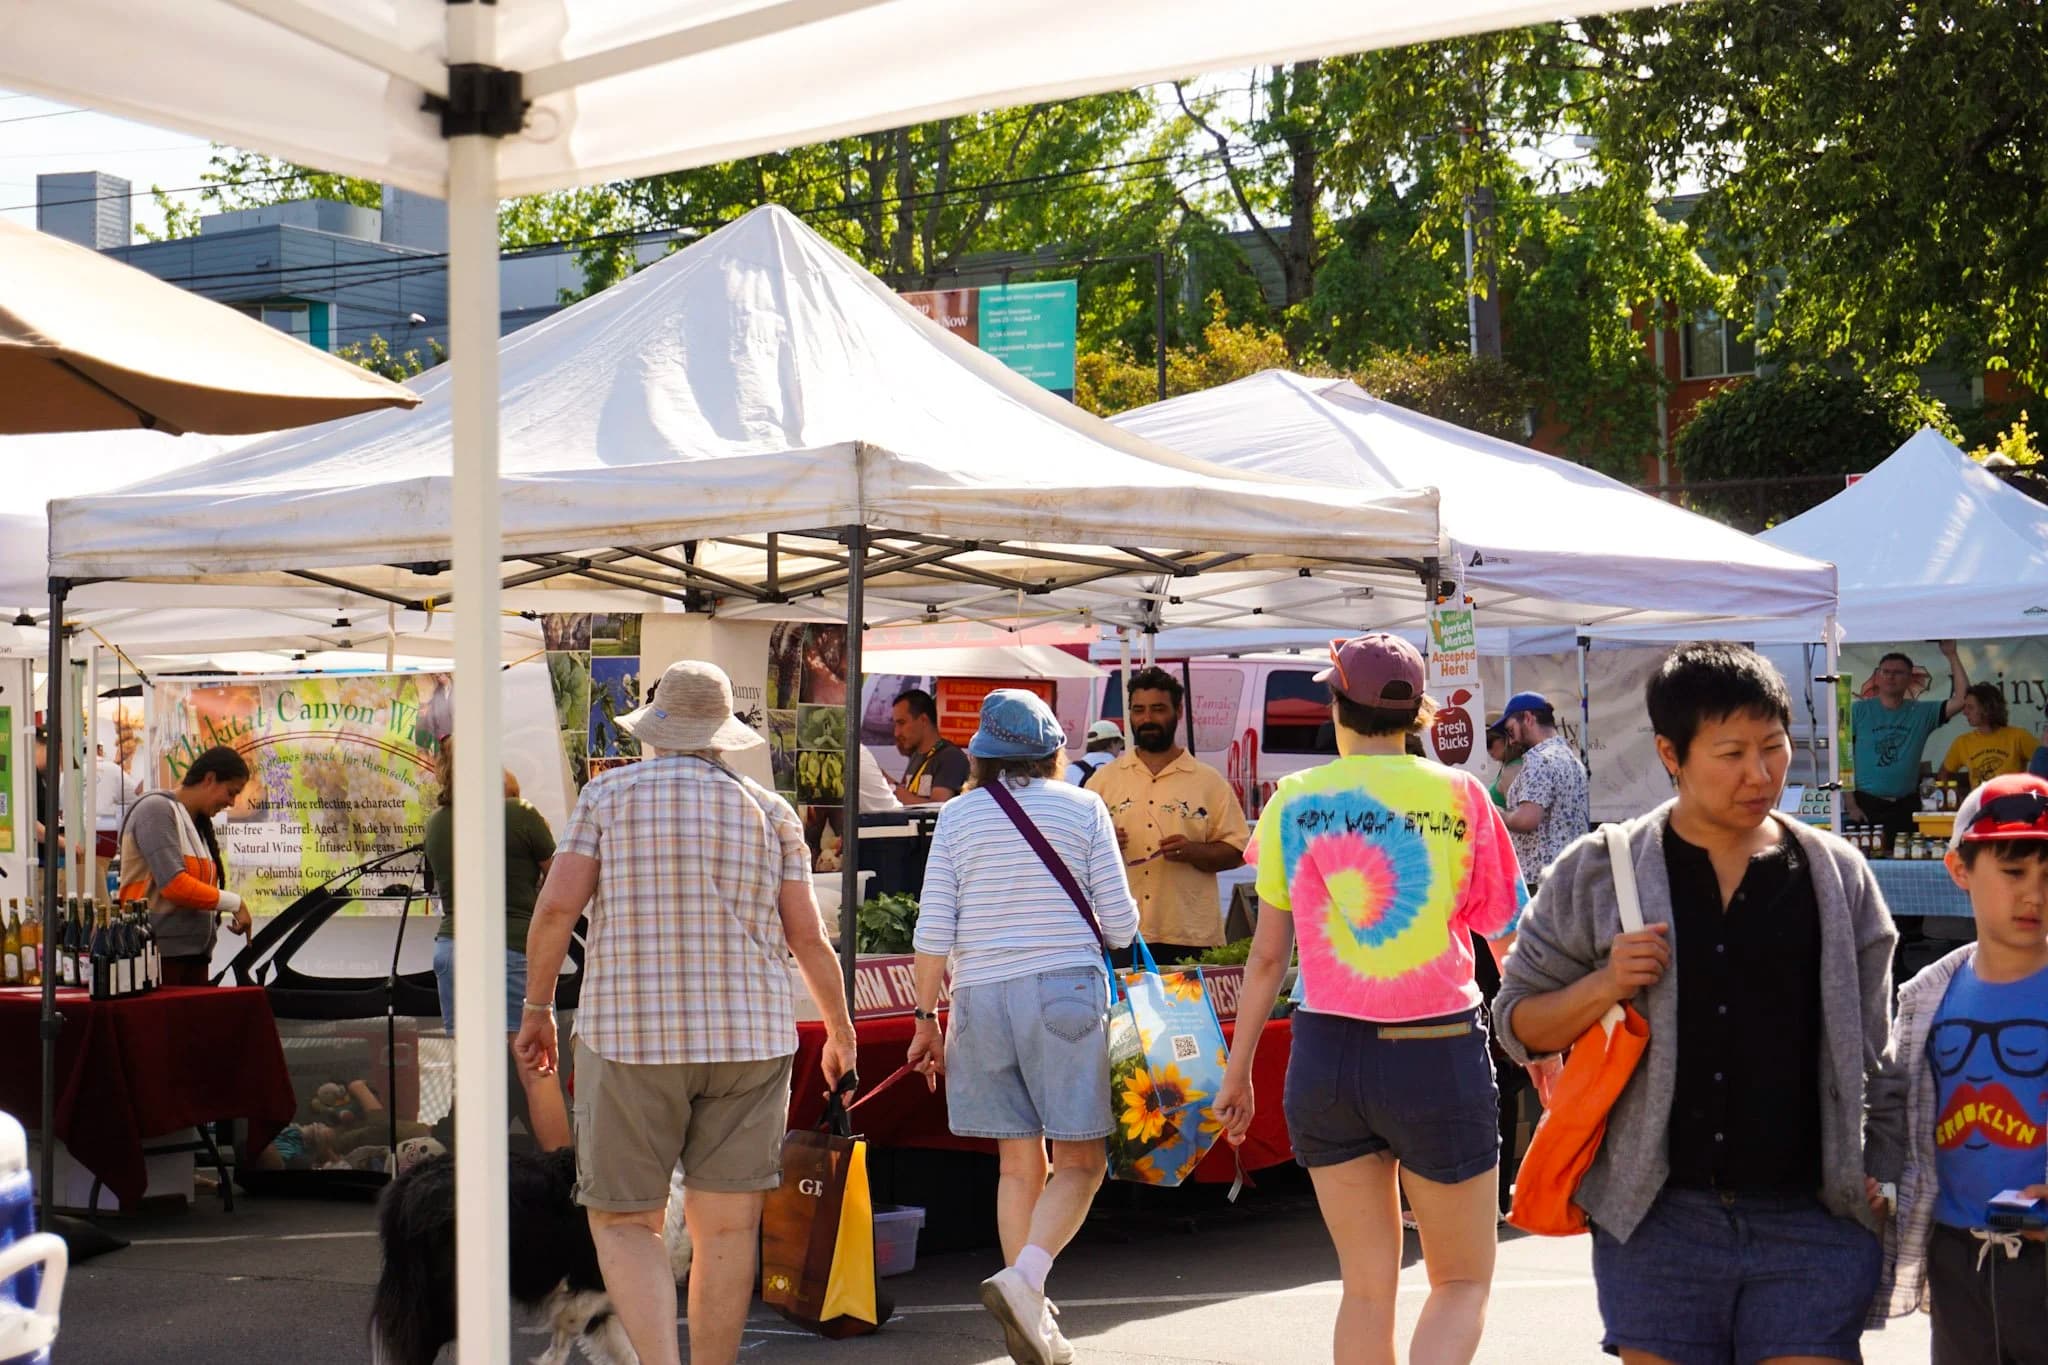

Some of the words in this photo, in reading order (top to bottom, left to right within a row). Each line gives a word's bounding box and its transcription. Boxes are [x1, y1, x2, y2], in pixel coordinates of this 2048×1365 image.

[943, 316, 968, 328] Now
[1441, 620, 1471, 636] Market
[1445, 631, 1473, 648] Match
[1432, 649, 1476, 664] Accepted
[1441, 662, 1469, 676] Here!
[277, 690, 374, 728] Canyon
[1437, 719, 1467, 736] Fresh
[1438, 735, 1470, 751] Bucks
[248, 797, 284, 810] Natural
[287, 799, 307, 809] wine
[310, 796, 352, 812] reflecting
[361, 797, 407, 809] character
[215, 823, 263, 836] ulfite-free
[280, 822, 338, 836] Barrel-Aged
[352, 822, 376, 834] Made
[380, 822, 392, 836] by
[234, 841, 269, 853] Natural
[272, 841, 303, 853] Wines
[315, 840, 352, 853] Infused
[354, 841, 396, 855] Vinegars
[256, 866, 303, 880] Columbia
[305, 866, 336, 879] Gorge
[1205, 974, 1241, 1014] RESH
